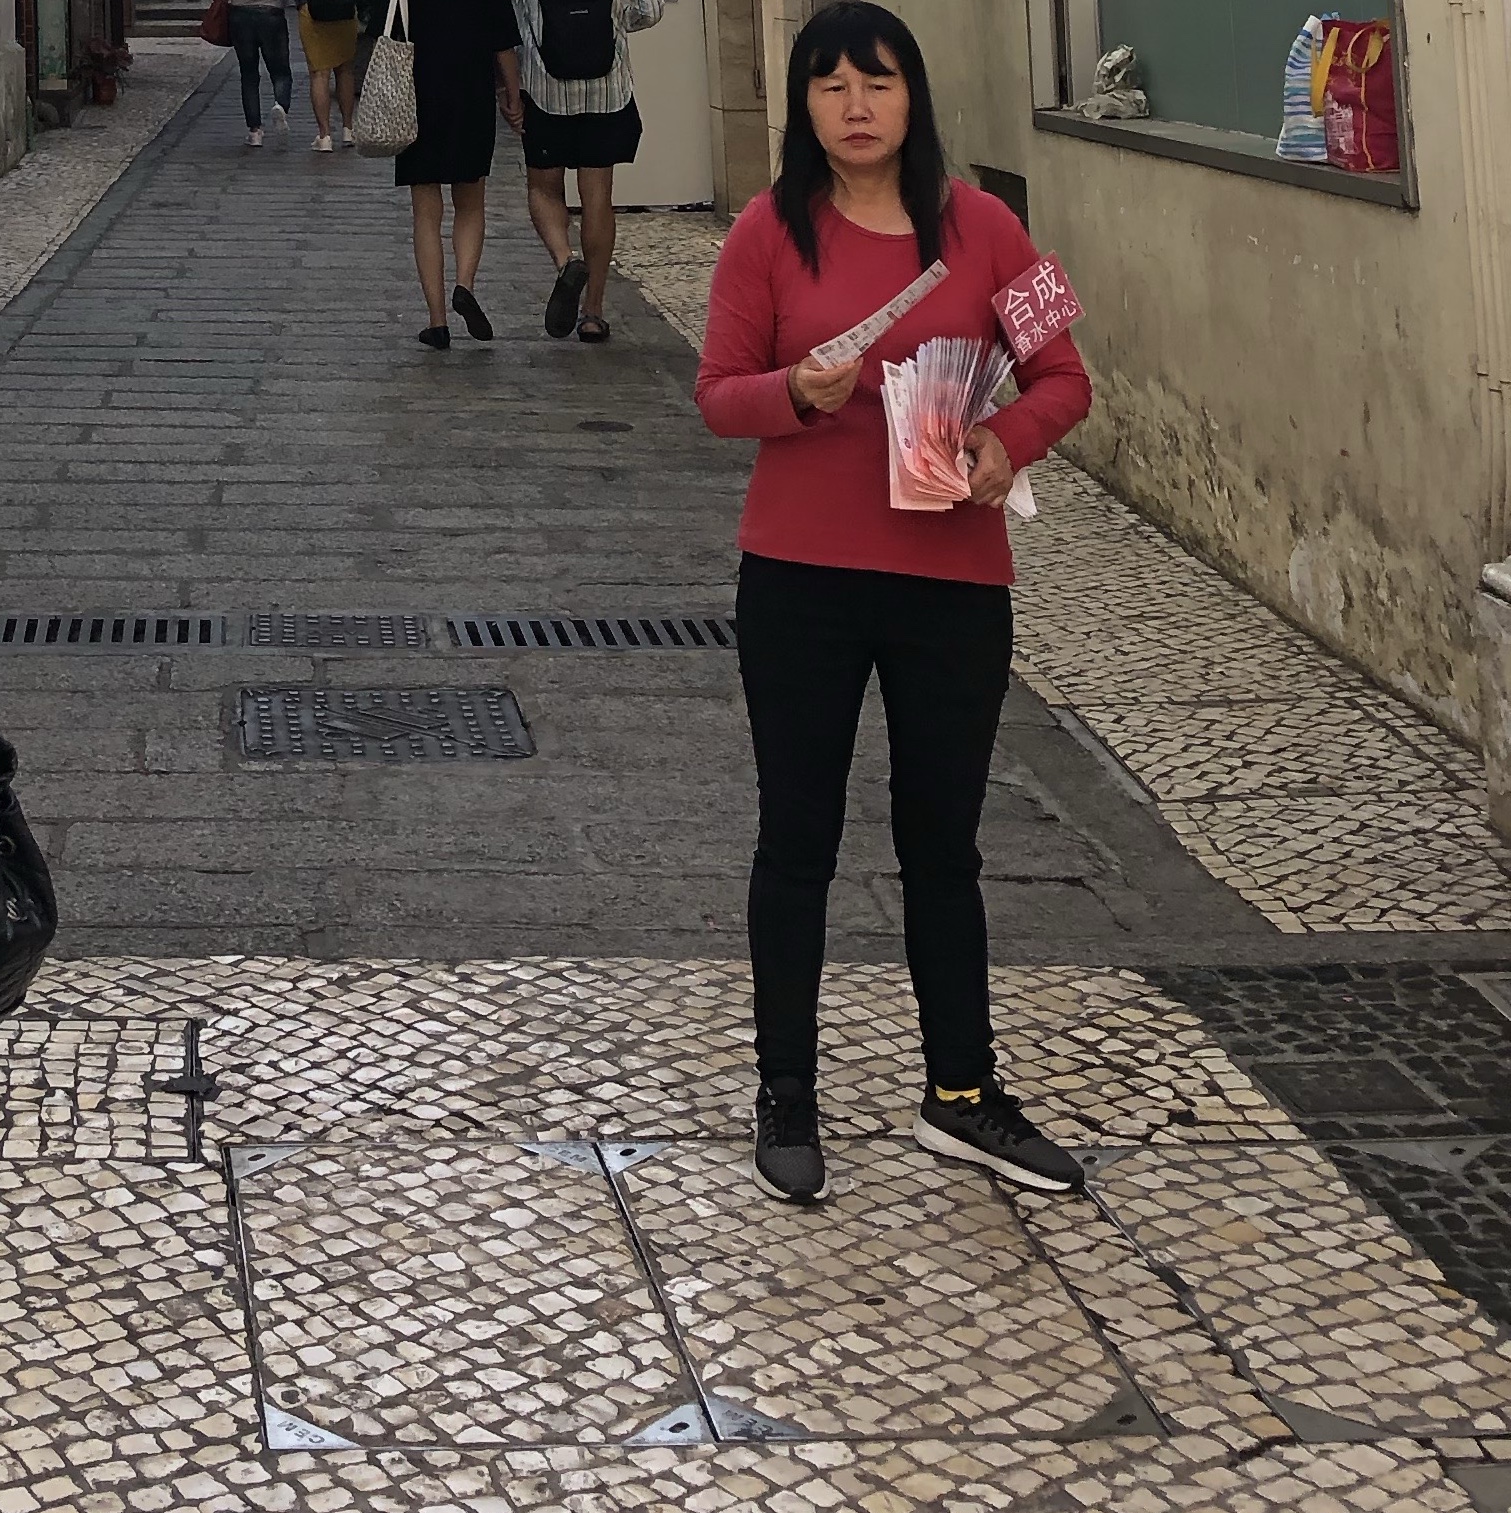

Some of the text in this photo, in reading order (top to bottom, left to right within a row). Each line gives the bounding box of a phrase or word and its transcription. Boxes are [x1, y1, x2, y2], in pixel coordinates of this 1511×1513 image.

[1004, 260, 1066, 330] 合成
[1014, 298, 1077, 355] 香水中心
